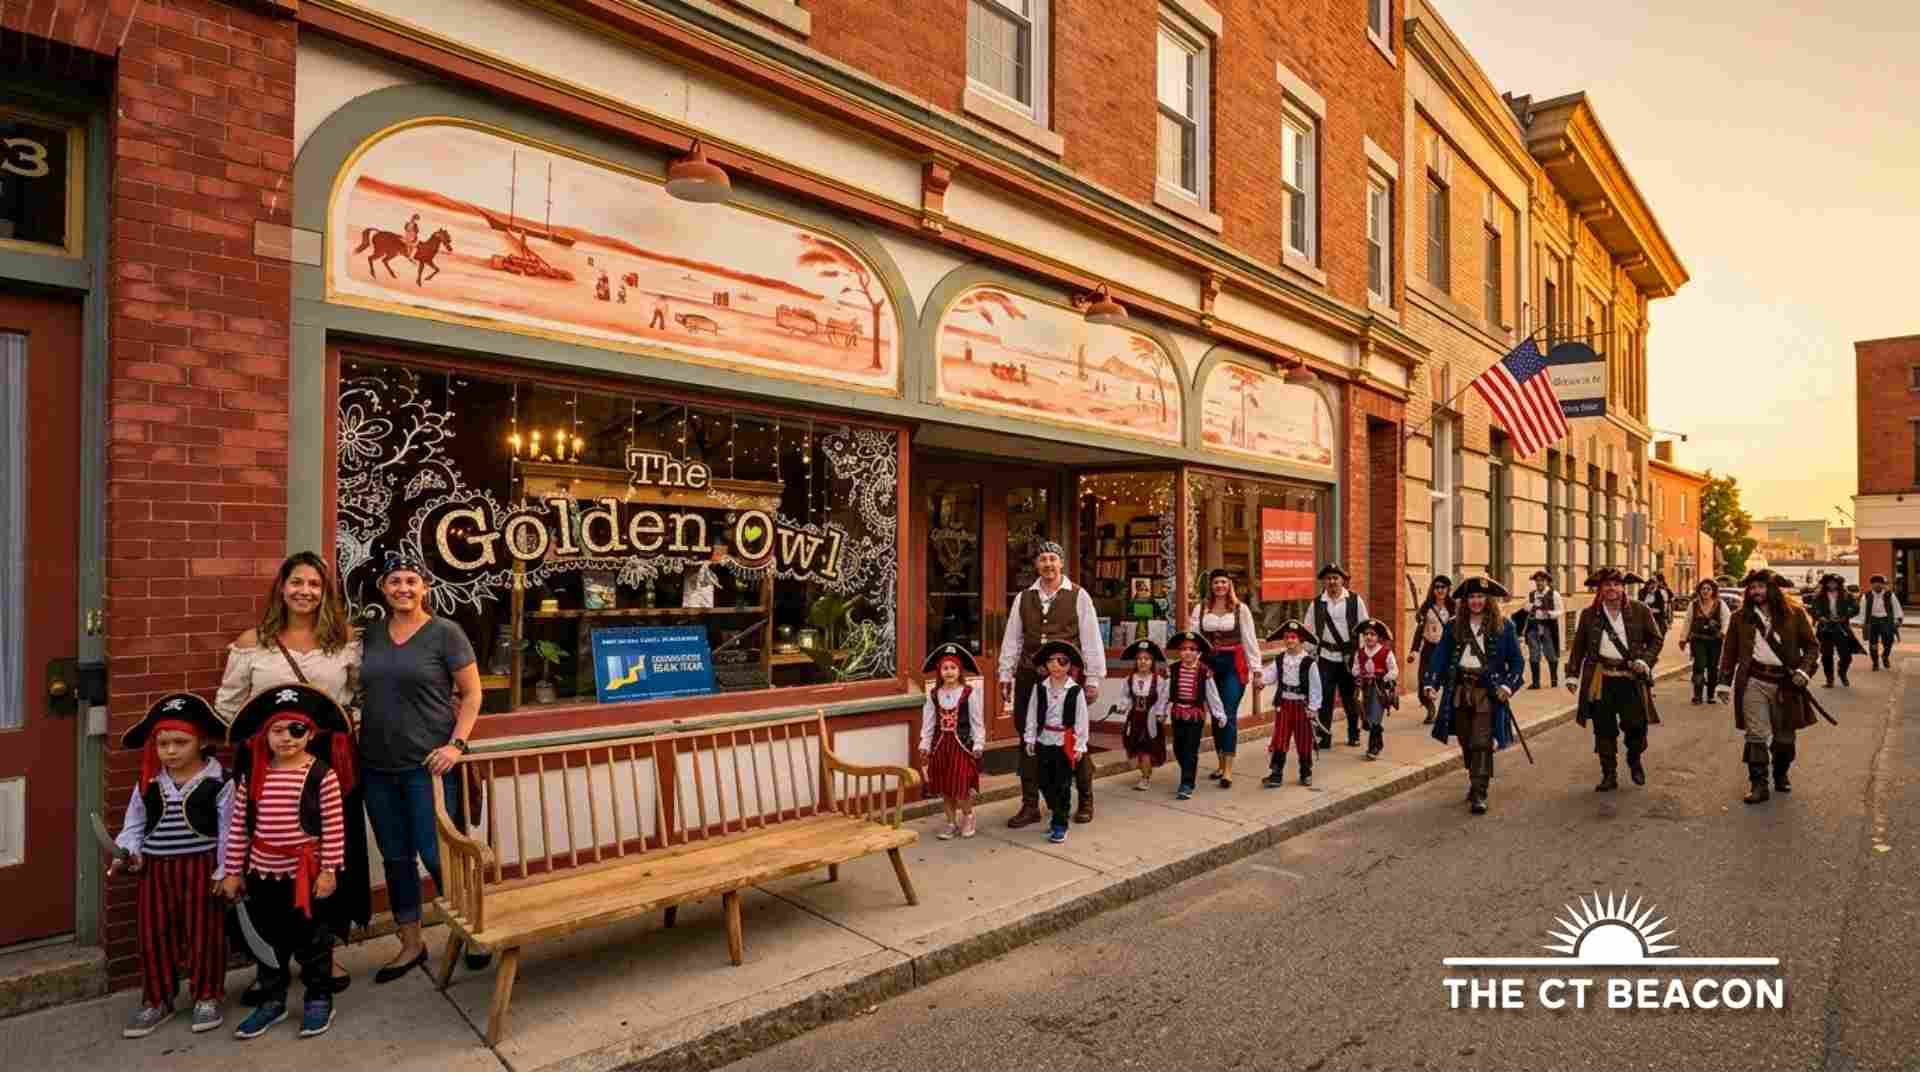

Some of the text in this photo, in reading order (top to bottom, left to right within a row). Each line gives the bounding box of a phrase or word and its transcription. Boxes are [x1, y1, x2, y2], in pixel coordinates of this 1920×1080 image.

[1, 137, 49, 177] 3
[630, 452, 708, 488] The
[435, 497, 842, 579] Golden Owl
